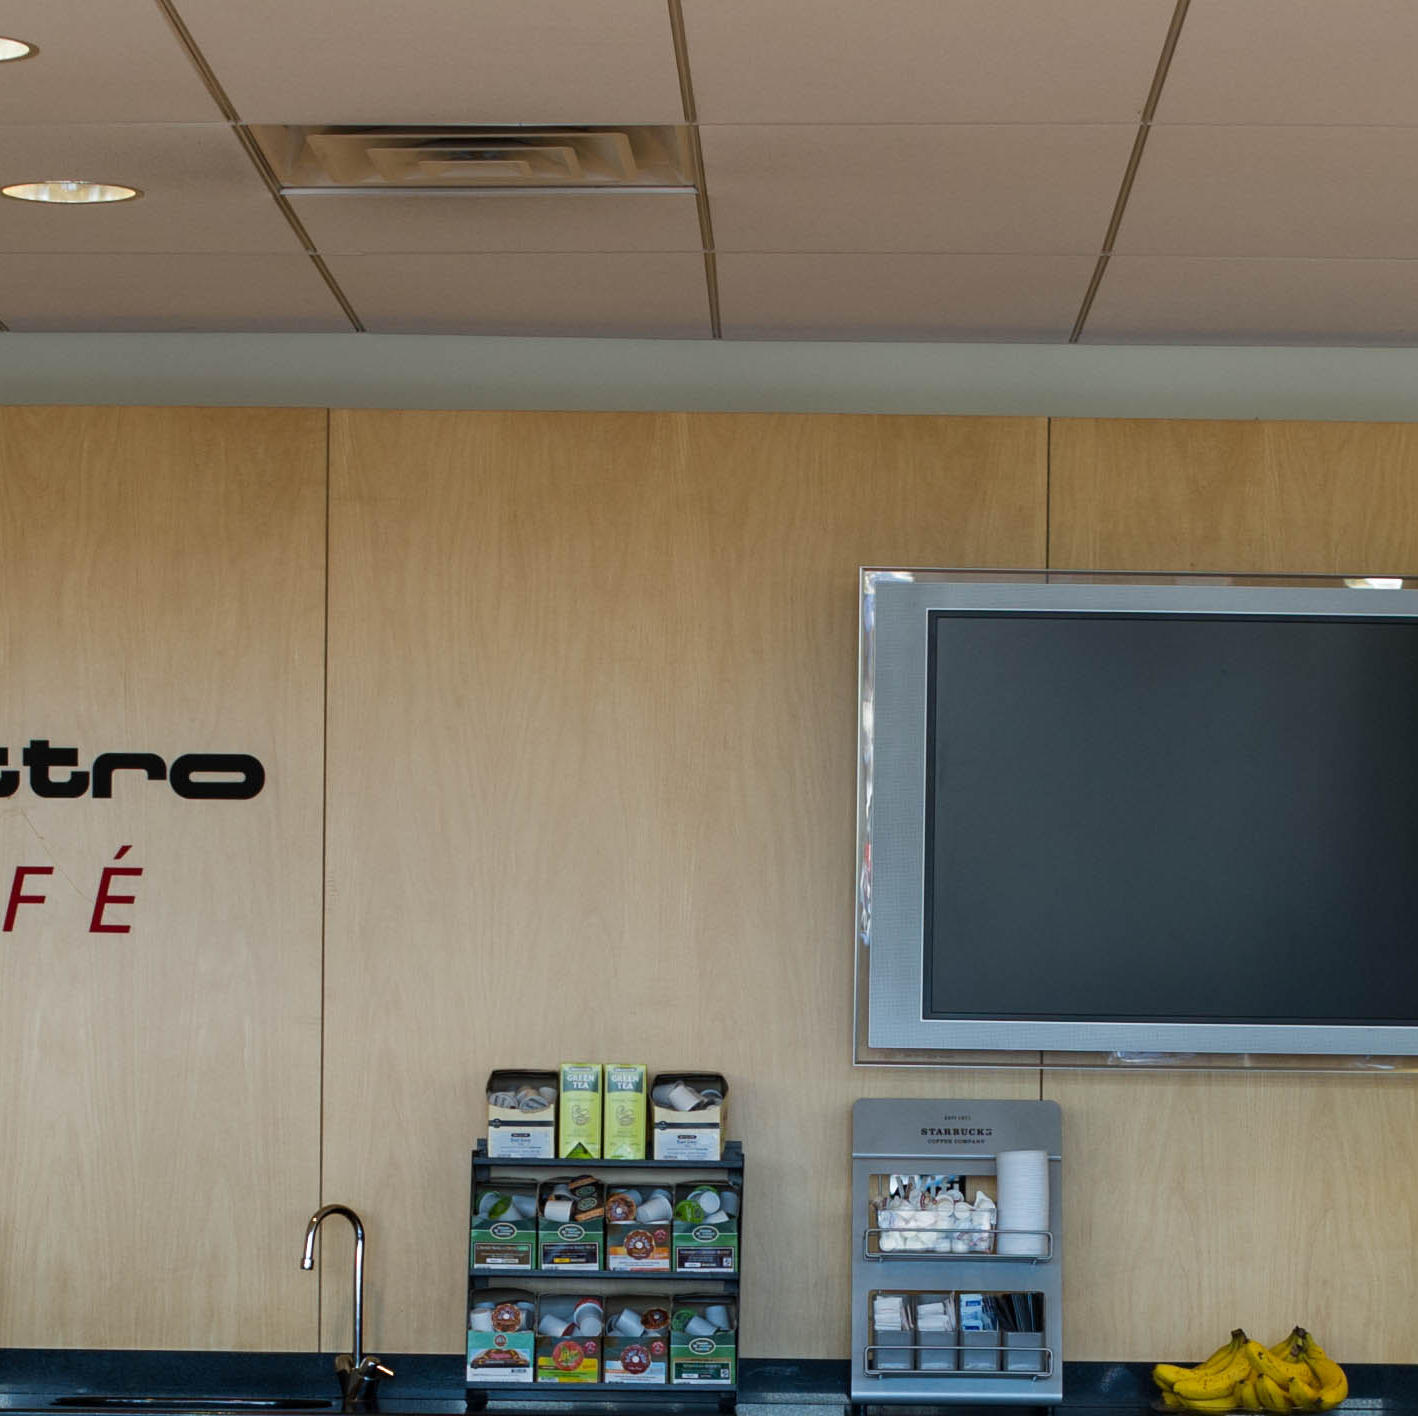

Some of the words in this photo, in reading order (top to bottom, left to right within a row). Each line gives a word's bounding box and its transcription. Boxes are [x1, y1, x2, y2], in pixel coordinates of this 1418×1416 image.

[566, 1074, 595, 1082] GREEN
[611, 1074, 640, 1082] GREEN
[573, 1081, 589, 1089] TEA
[617, 1082, 634, 1090] TEA
[920, 1127, 993, 1136] STARBUCKS
